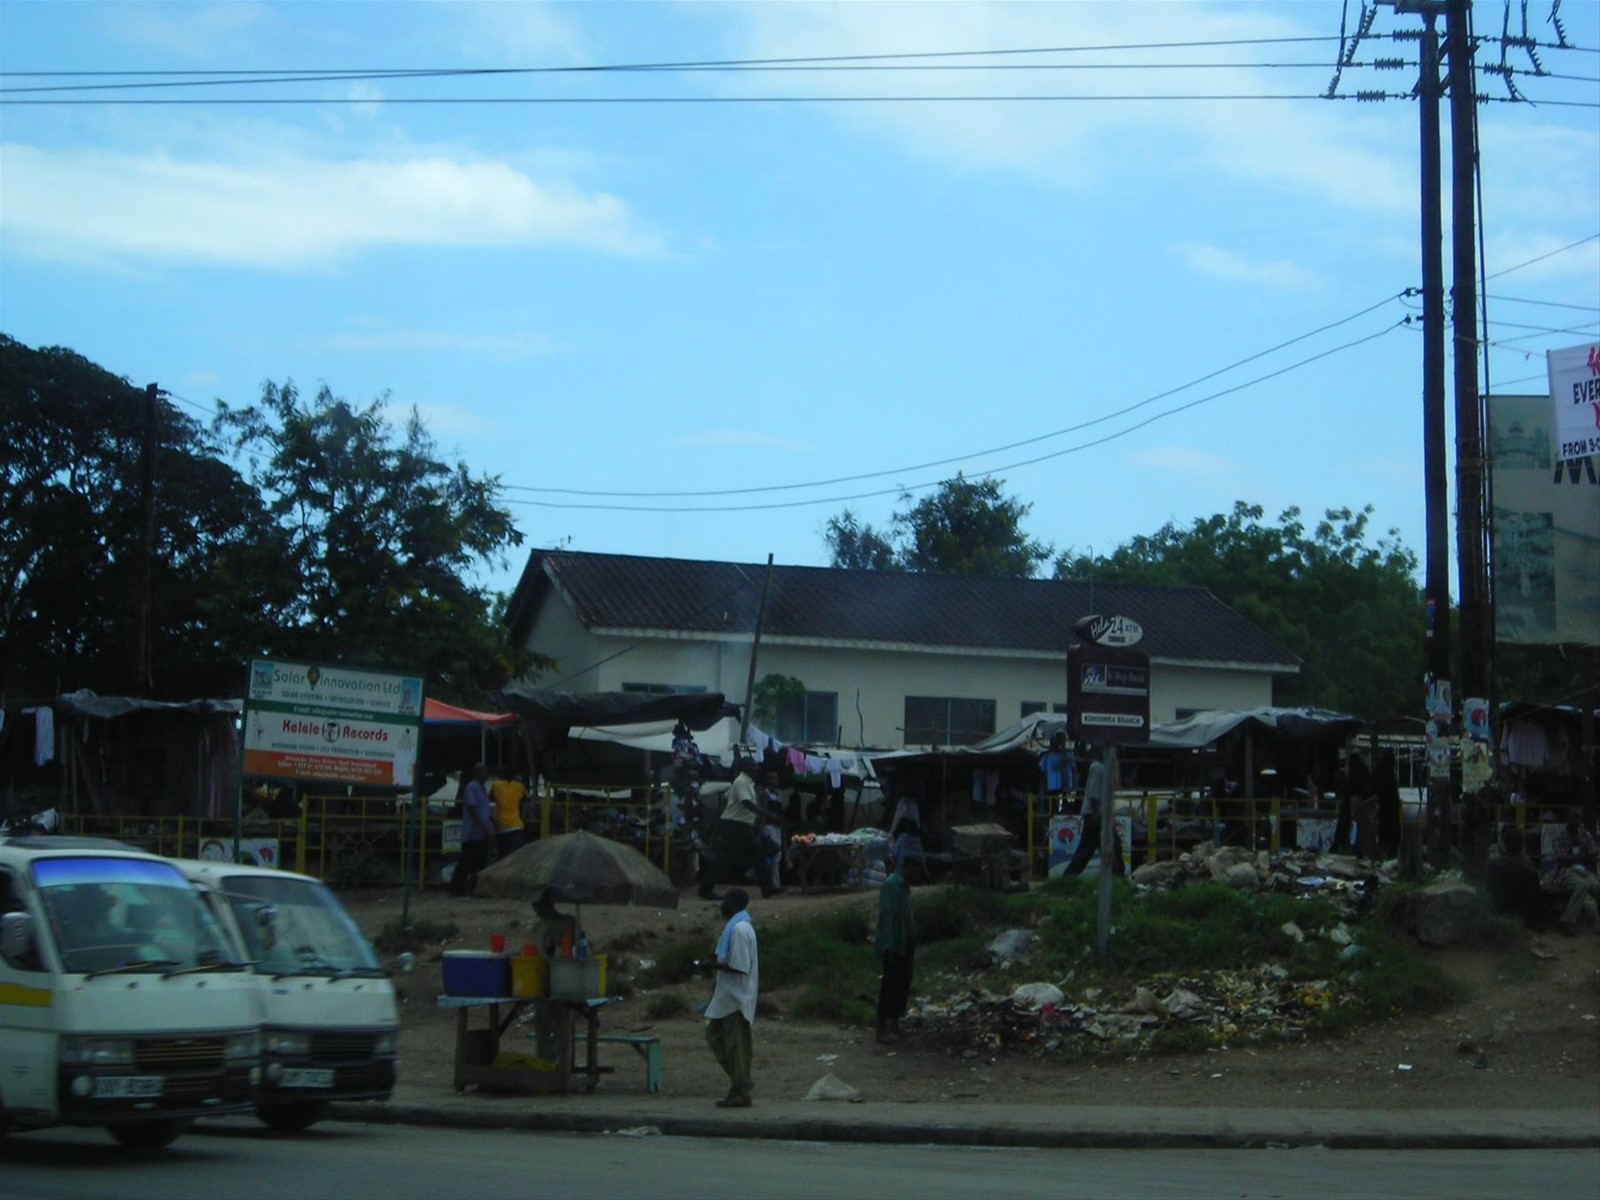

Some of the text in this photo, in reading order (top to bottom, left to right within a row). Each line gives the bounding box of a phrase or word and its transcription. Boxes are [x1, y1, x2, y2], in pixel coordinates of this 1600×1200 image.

[1563, 440, 1587, 457] FROM
[1111, 618, 1124, 635] 24
[273, 668, 400, 695] Solar Innovation Ltd
[282, 719, 388, 742] Kelele Records
